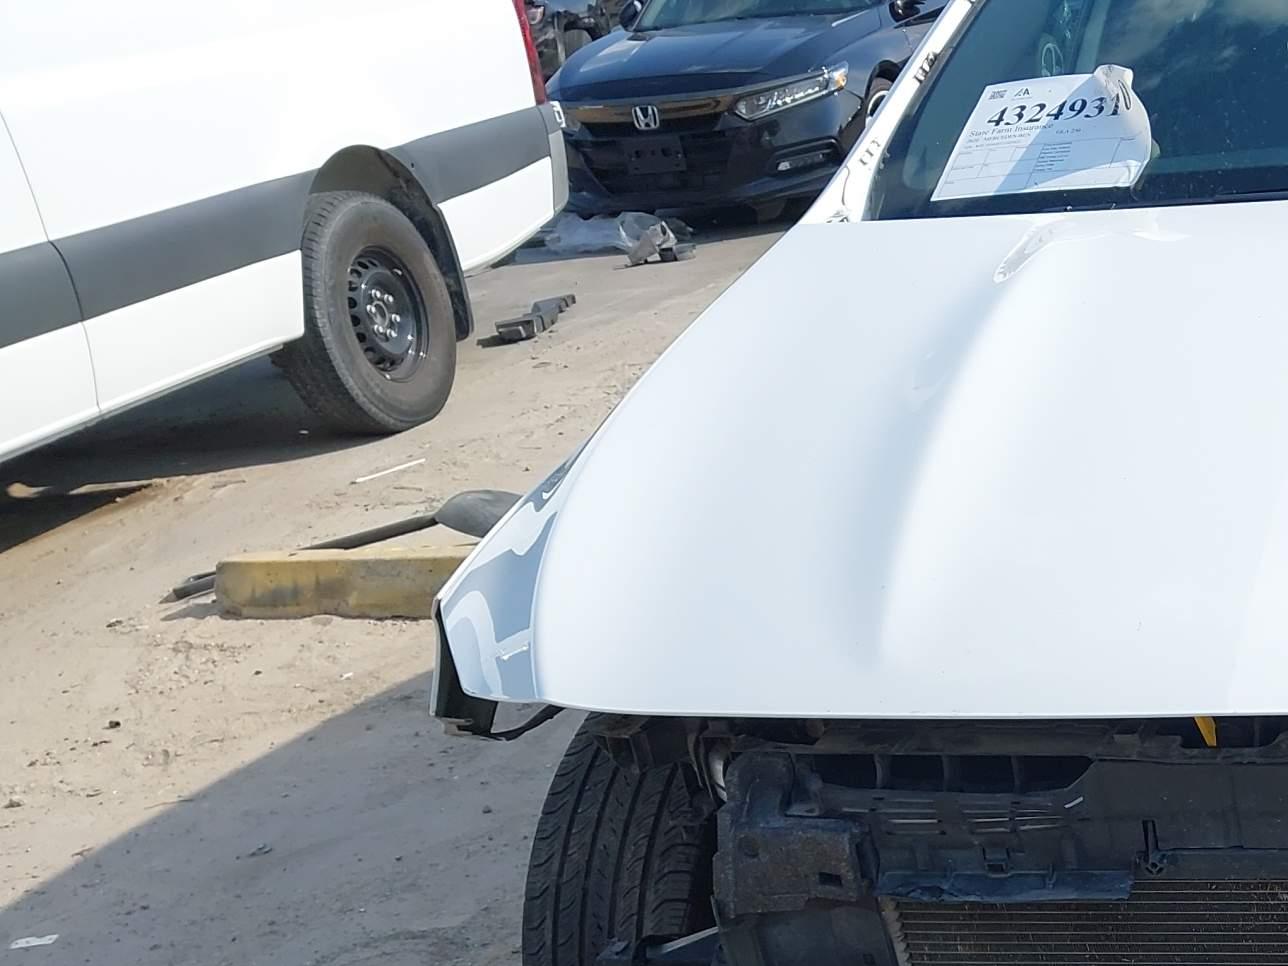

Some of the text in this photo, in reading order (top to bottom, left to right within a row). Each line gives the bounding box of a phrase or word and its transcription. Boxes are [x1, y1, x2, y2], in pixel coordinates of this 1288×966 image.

[987, 79, 1132, 127] 43249310
[969, 122, 1054, 138] State Farm Insurance
